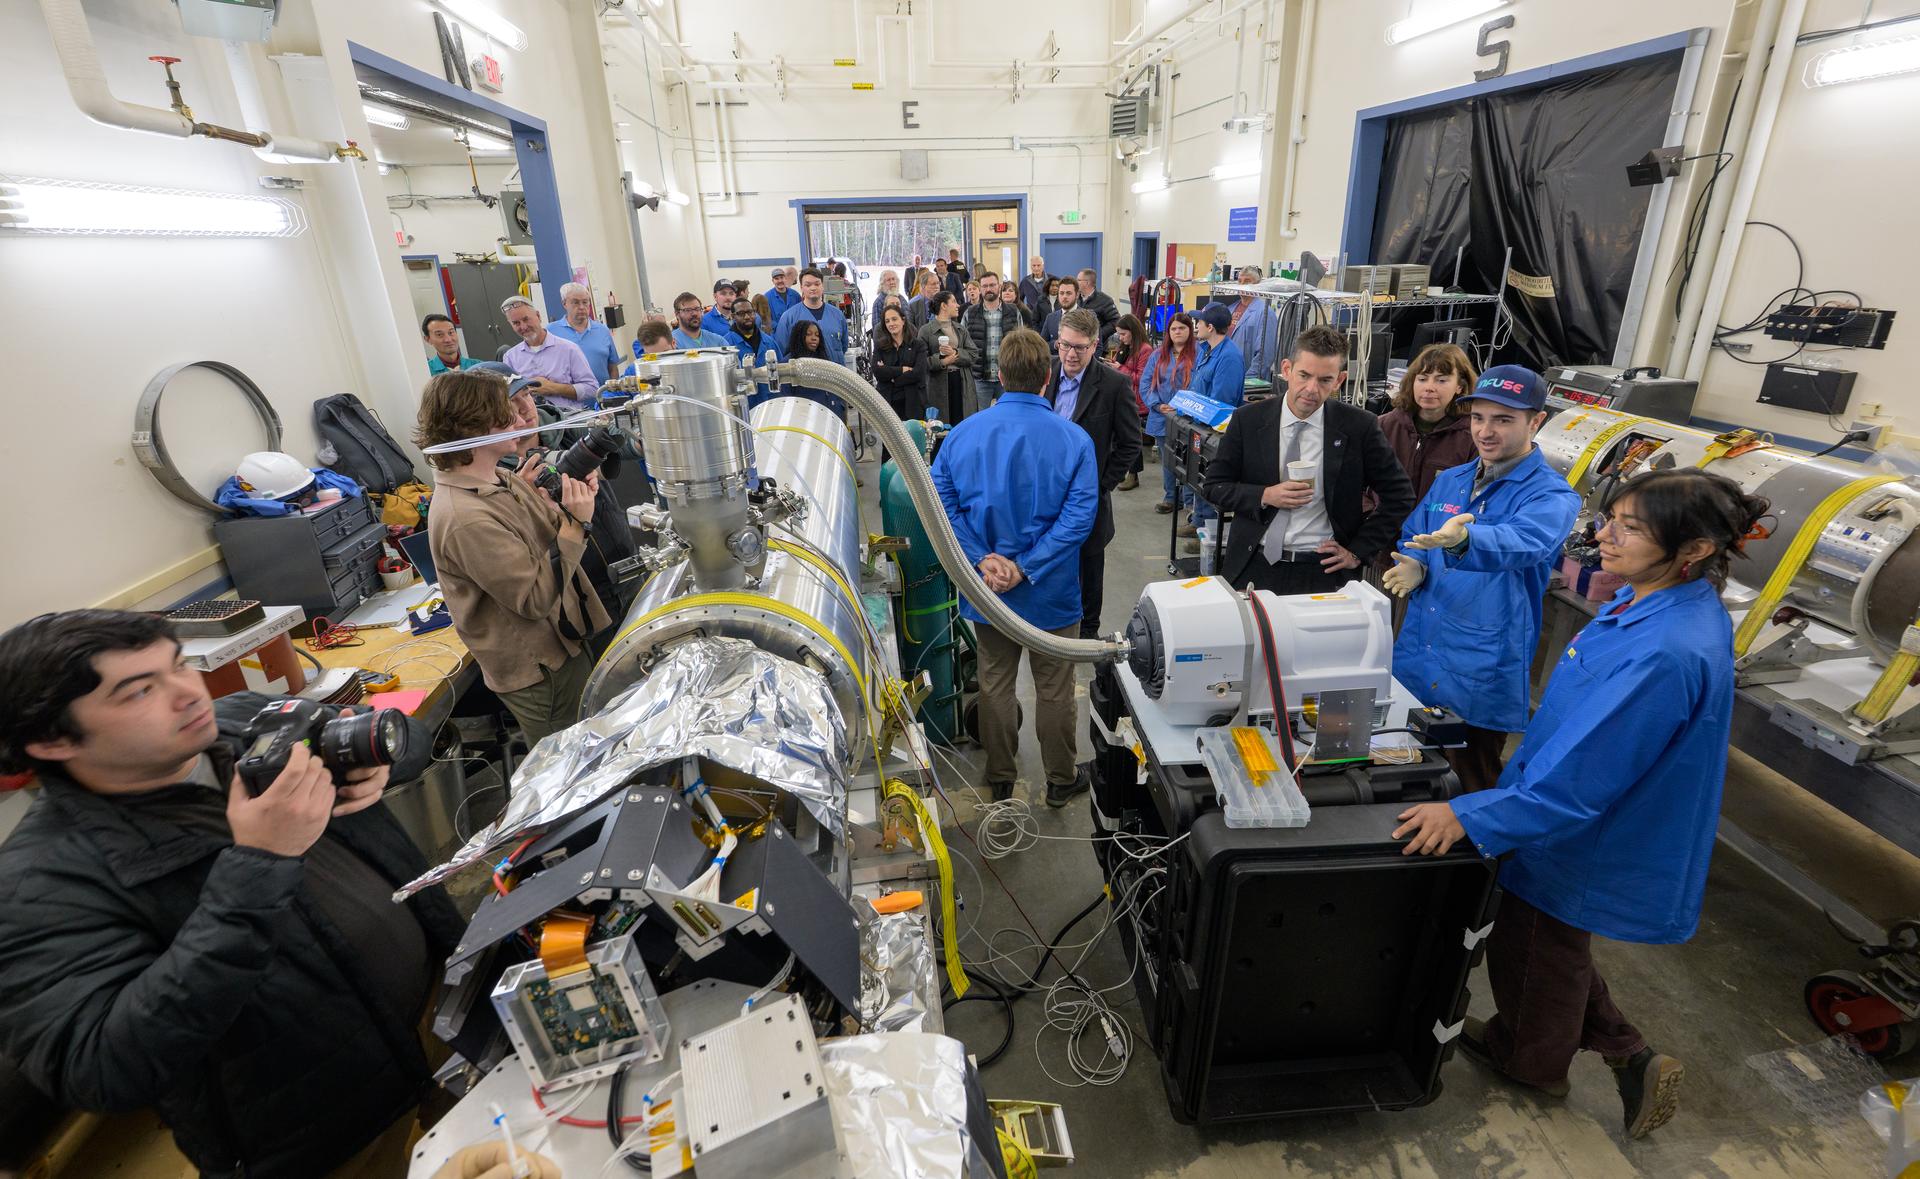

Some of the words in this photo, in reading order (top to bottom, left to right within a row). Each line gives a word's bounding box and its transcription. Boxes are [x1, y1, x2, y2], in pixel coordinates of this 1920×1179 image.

[433, 12, 472, 91] N
[1474, 15, 1515, 82] S
[484, 55, 501, 87] EXIT
[903, 101, 919, 128] E
[1477, 377, 1525, 394] INFUSE
